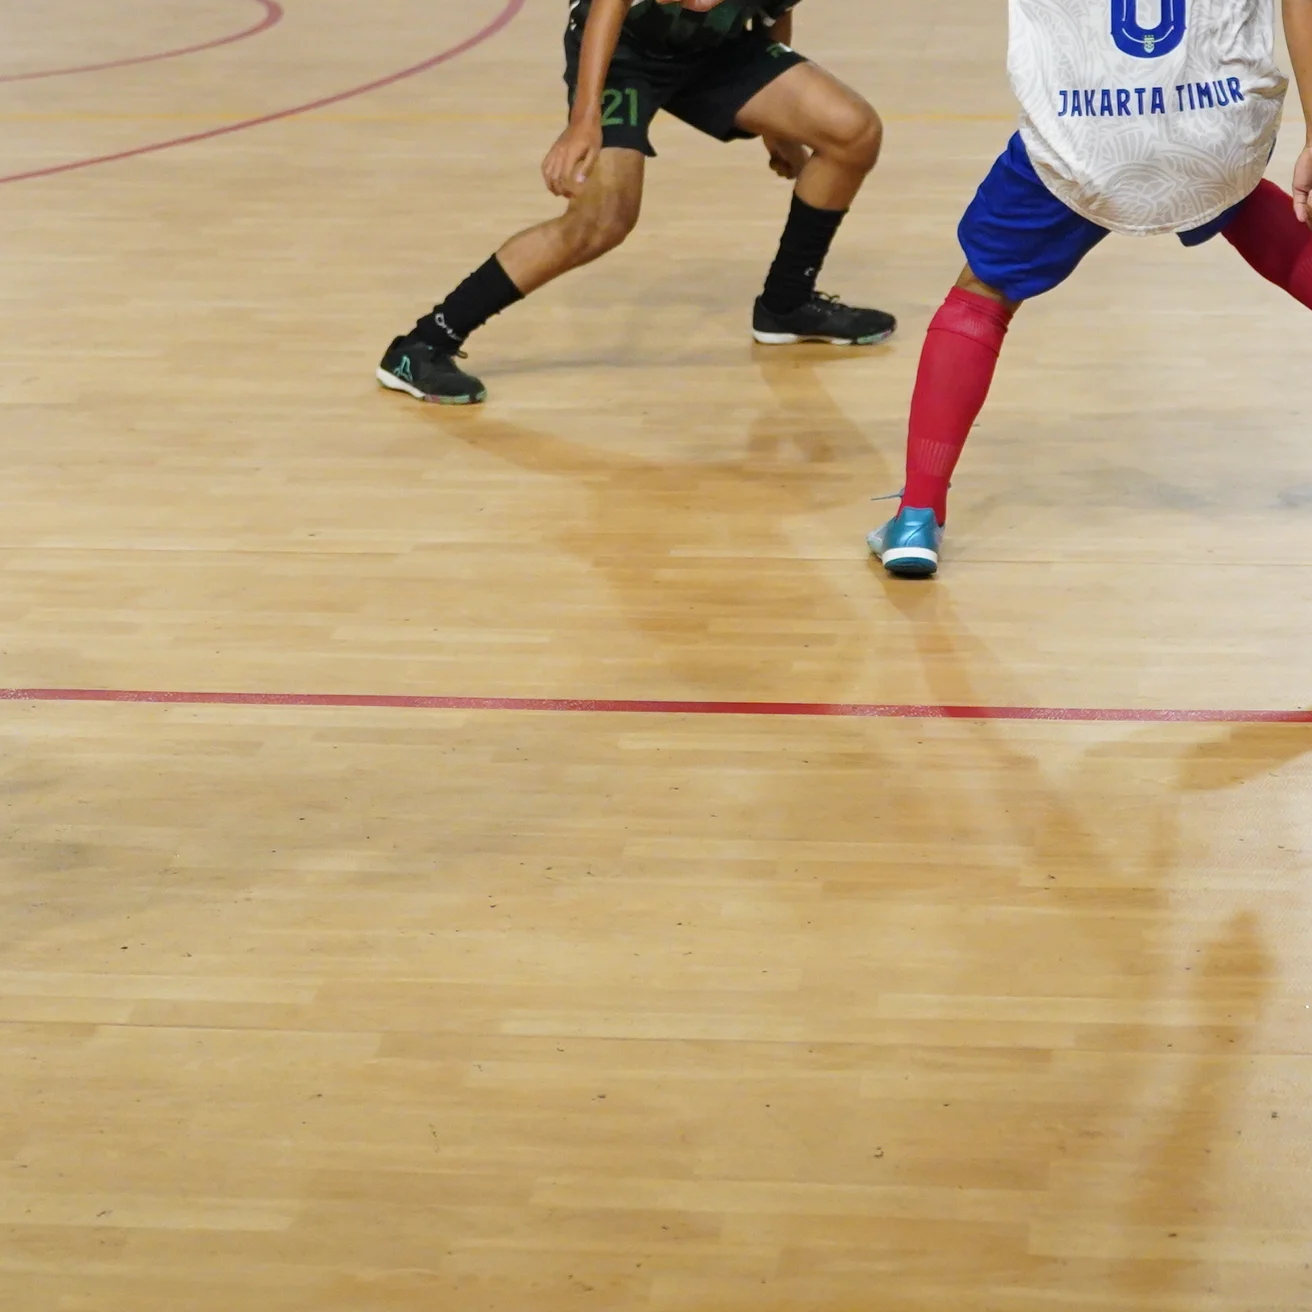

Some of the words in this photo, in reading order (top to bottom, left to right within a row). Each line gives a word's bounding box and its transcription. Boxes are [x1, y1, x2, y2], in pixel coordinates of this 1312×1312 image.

[600, 87, 639, 128] 21
[1058, 85, 1166, 118] JAKARTA
[1175, 76, 1246, 109] TIMUR
